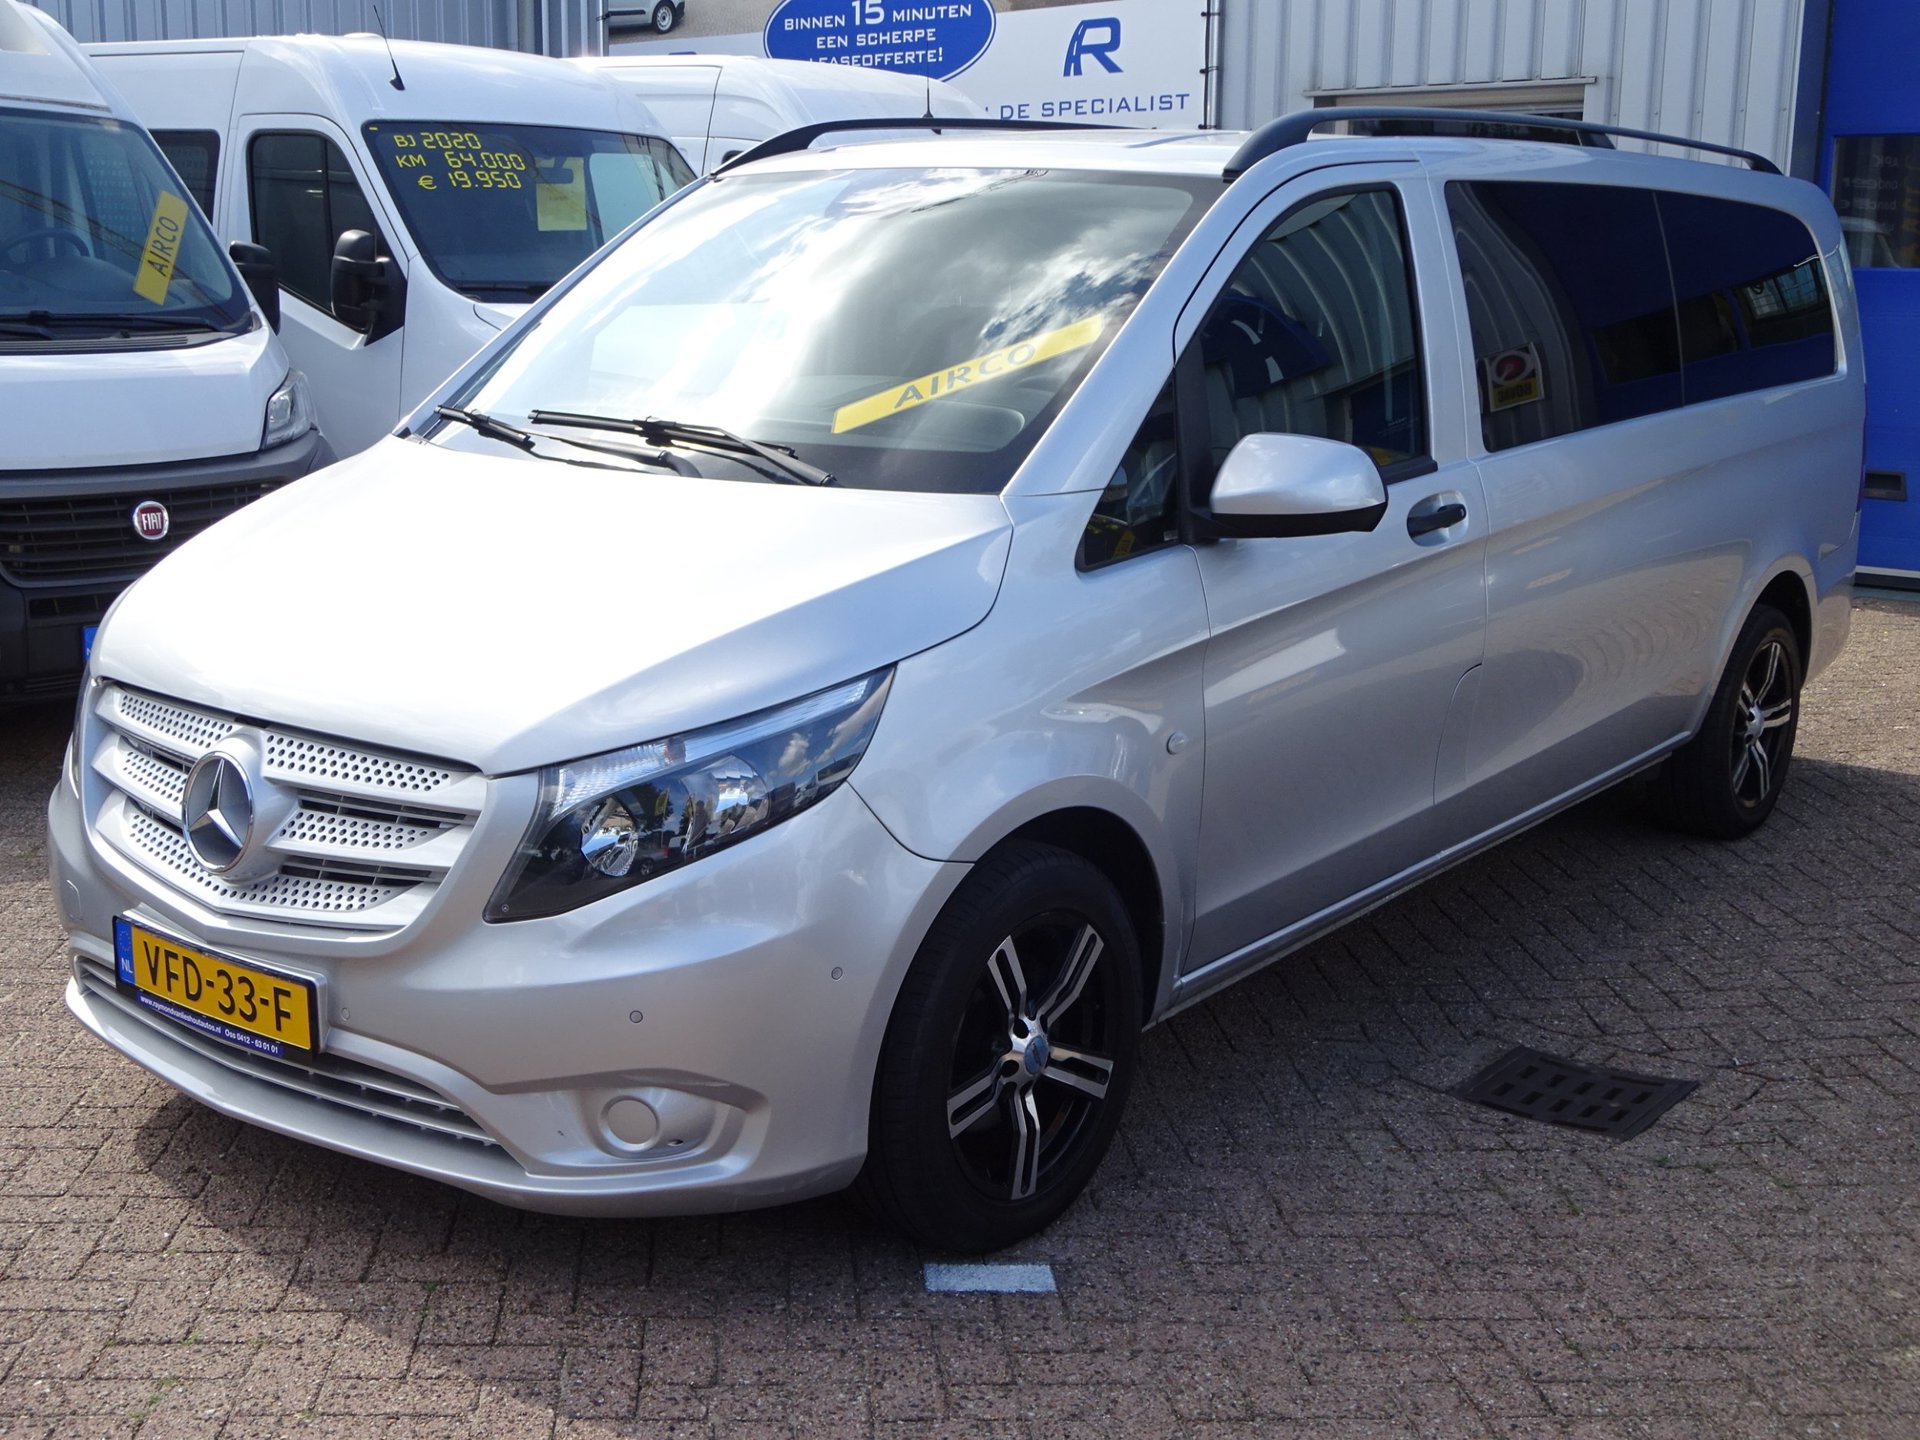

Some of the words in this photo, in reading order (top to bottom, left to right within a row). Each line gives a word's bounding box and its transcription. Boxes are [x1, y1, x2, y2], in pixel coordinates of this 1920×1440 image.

[784, 15, 846, 31] BINNEN
[851, 0, 885, 26] 15
[892, 4, 972, 23] MINUTEN
[816, 35, 848, 49] EEN
[856, 28, 936, 47] SCHERPE
[809, 47, 943, 66] ASEOFFERTE!
[1000, 104, 1030, 120] DE
[1041, 93, 1190, 118] SPECIALIST
[420, 132, 482, 150] 2020
[395, 154, 427, 168] KM
[444, 151, 526, 171] 64.000
[417, 175, 437, 190] €
[448, 170, 522, 189] 19.950
[147, 215, 179, 278] AIRCO
[893, 343, 1036, 409] AIRCO
[141, 512, 163, 531] FIAT
[120, 957, 134, 974] NL
[143, 941, 291, 1032] VFD-33-F
[225, 1029, 236, 1039] Oss
[236, 1033, 251, 1045] 0412
[271, 1045, 279, 1054] 01
